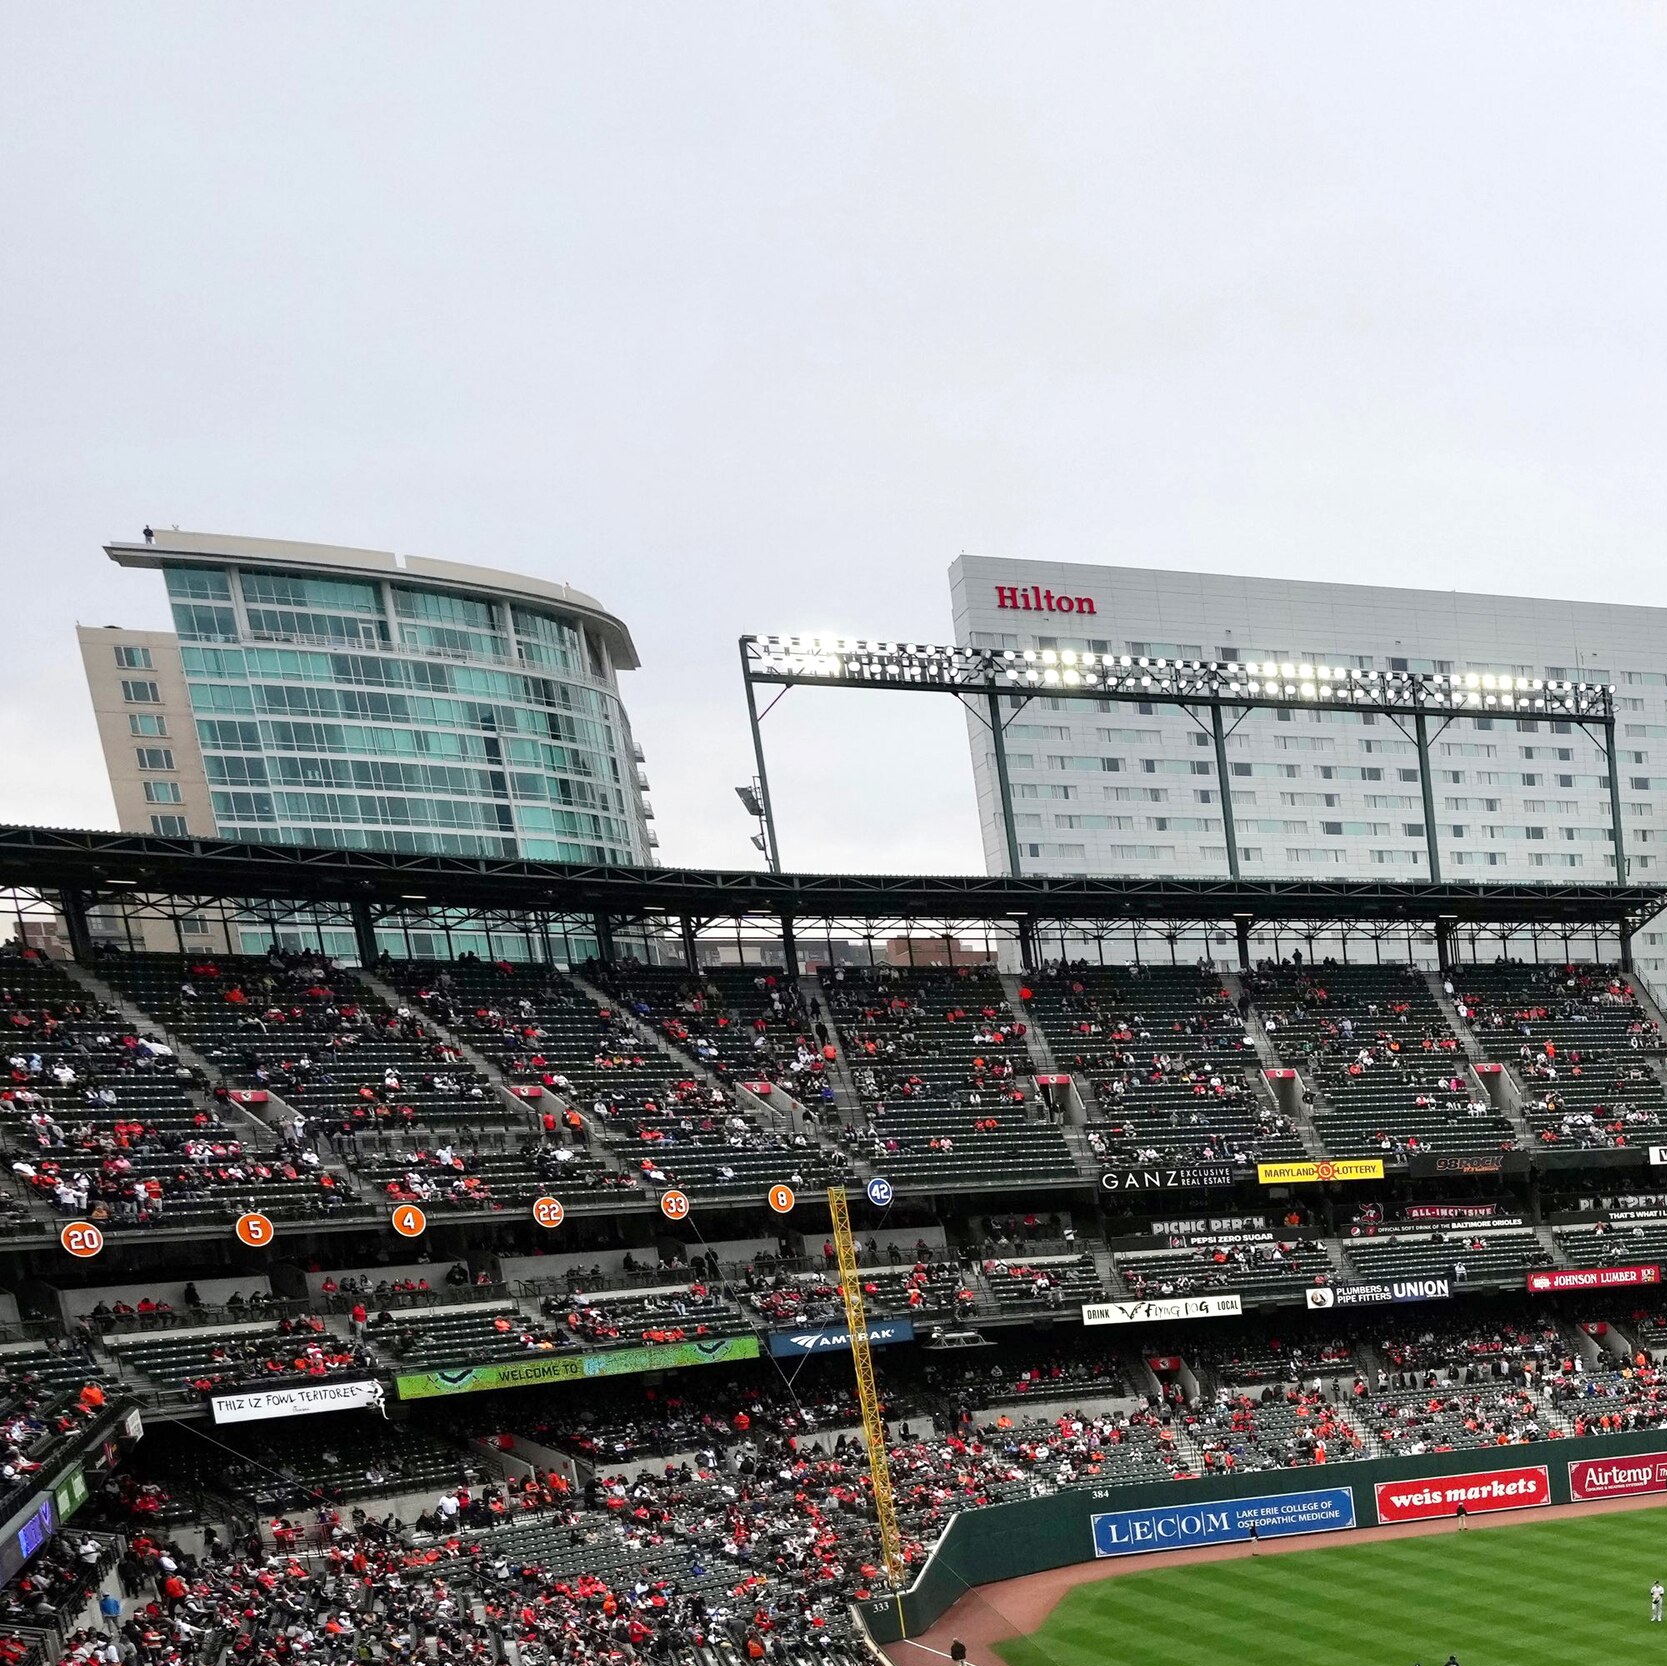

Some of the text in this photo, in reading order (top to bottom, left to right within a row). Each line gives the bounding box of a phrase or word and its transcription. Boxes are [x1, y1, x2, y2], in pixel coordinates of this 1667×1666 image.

[995, 586, 1097, 615] Hilton
[1102, 1170, 1179, 1190] GANZ
[1180, 1168, 1230, 1178] EXCLUSIVE
[1181, 1175, 1231, 1185] REAL ESTATE
[1264, 1165, 1378, 1178] MARYLAND LOTTERY
[777, 1193, 787, 1207] 8
[870, 1185, 890, 1199] 42
[538, 1203, 561, 1221] 22
[665, 1196, 686, 1213] 33
[402, 1213, 415, 1230] 4
[1451, 1220, 1491, 1229] BALTIMORE
[1492, 1218, 1522, 1226] ORIOLES
[1609, 1212, 1635, 1220] THAT'S
[1636, 1210, 1657, 1218] WHAT
[248, 1220, 263, 1239] 5
[1152, 1219, 1206, 1235] PICNIC
[68, 1230, 99, 1250] 20
[1191, 1233, 1273, 1245] PEPSI ZERO SUGAR
[1554, 1270, 1637, 1286] JOHNSON LUMBER
[1336, 1285, 1382, 1295] PLUMBERS
[1393, 1280, 1449, 1297] UNION
[1337, 1292, 1392, 1303] PIPE FITTERS
[1087, 1309, 1110, 1320] DRINK
[1217, 1300, 1239, 1310] LOCAL
[498, 1363, 579, 1383] WELCOME TO
[217, 1385, 358, 1412] THIZ IZ FOWL TERITOREE
[1584, 1465, 1652, 1487] Airtemp
[1092, 1489, 1109, 1499] 384
[1390, 1478, 1537, 1508] weis markets
[1236, 1500, 1333, 1518] LAKE ERIE COLLEGE OF
[1237, 1509, 1340, 1529] OSTEOPATHIC MEDICINE
[873, 1601, 889, 1613] 333
